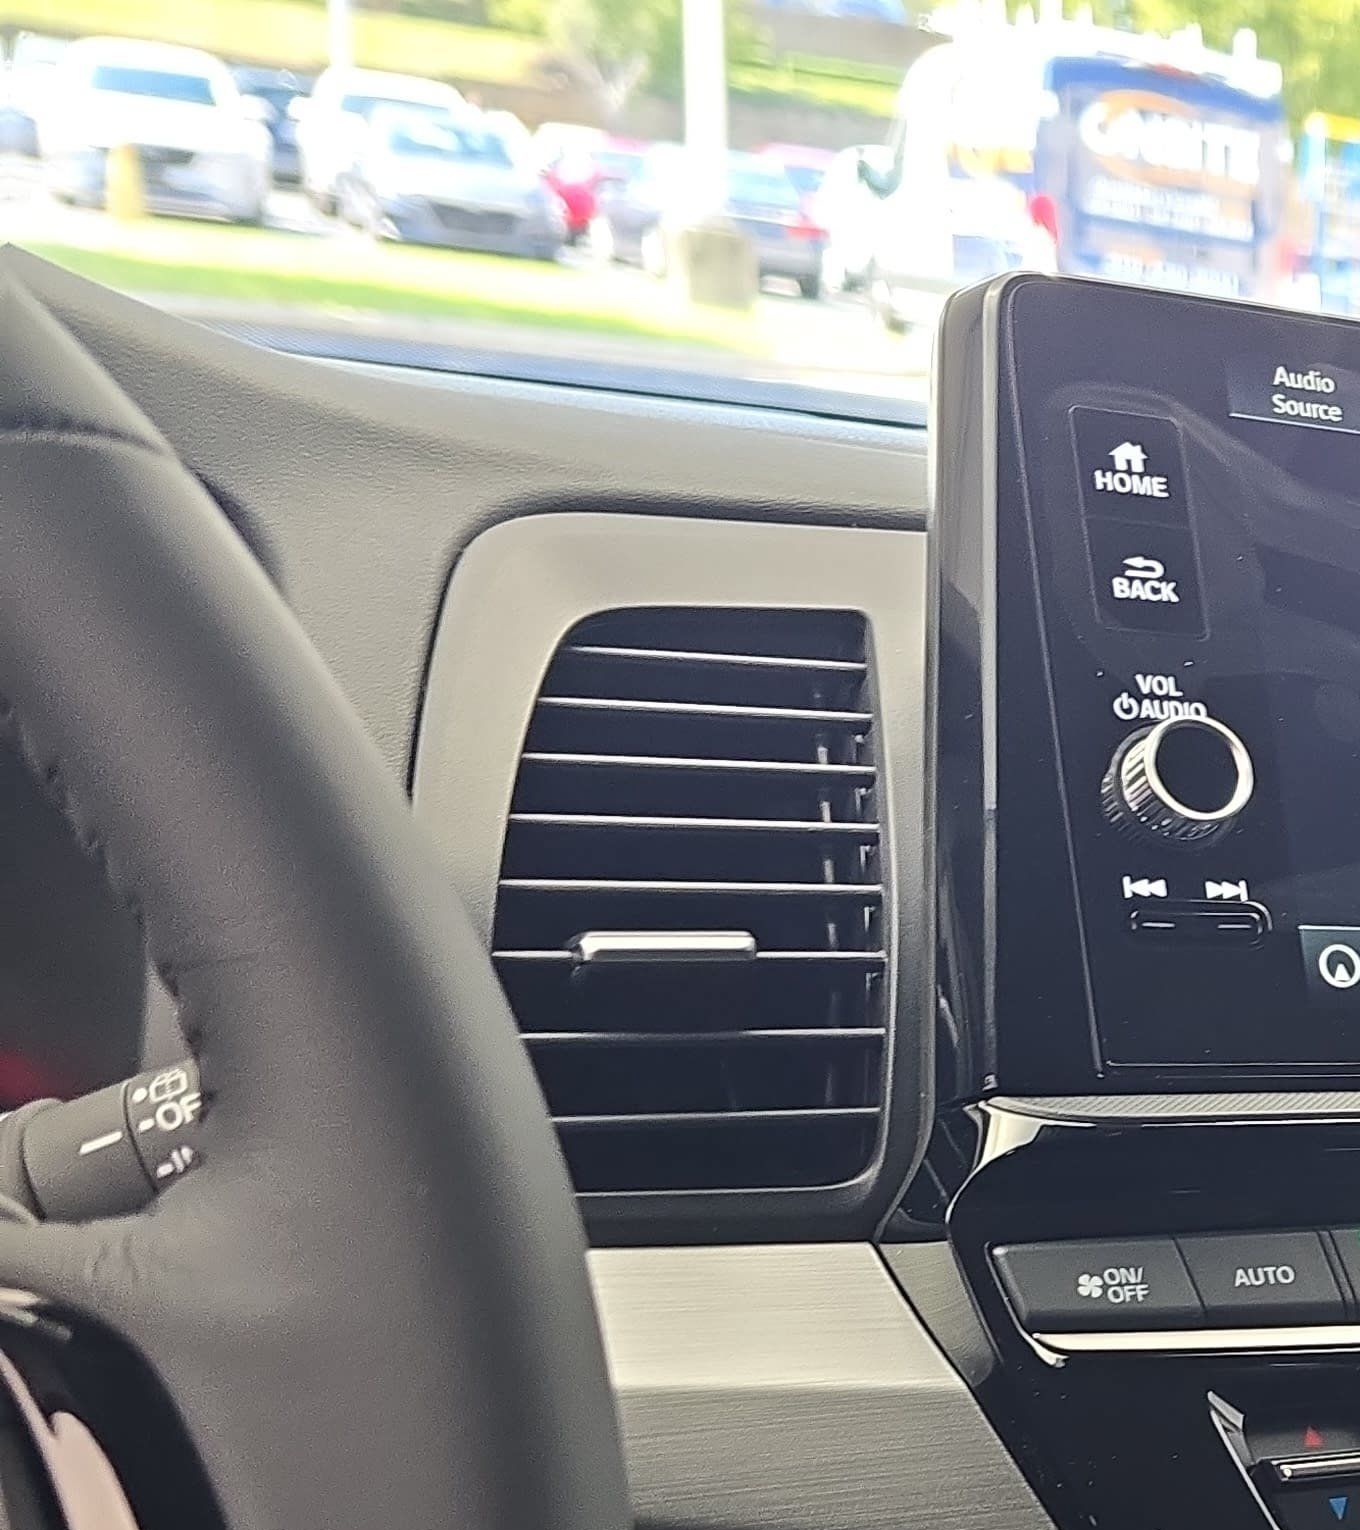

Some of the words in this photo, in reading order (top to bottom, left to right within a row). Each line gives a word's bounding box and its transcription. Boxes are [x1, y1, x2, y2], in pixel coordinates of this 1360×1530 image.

[1273, 365, 1336, 394] Audio
[1271, 394, 1344, 422] Source
[1093, 469, 1170, 498] HOME
[1111, 576, 1180, 603] BACK
[1135, 673, 1183, 697] VOL
[1103, 1265, 1144, 1286] ON/
[1233, 1265, 1297, 1288] AUTO
[1107, 1283, 1150, 1304] OFF
